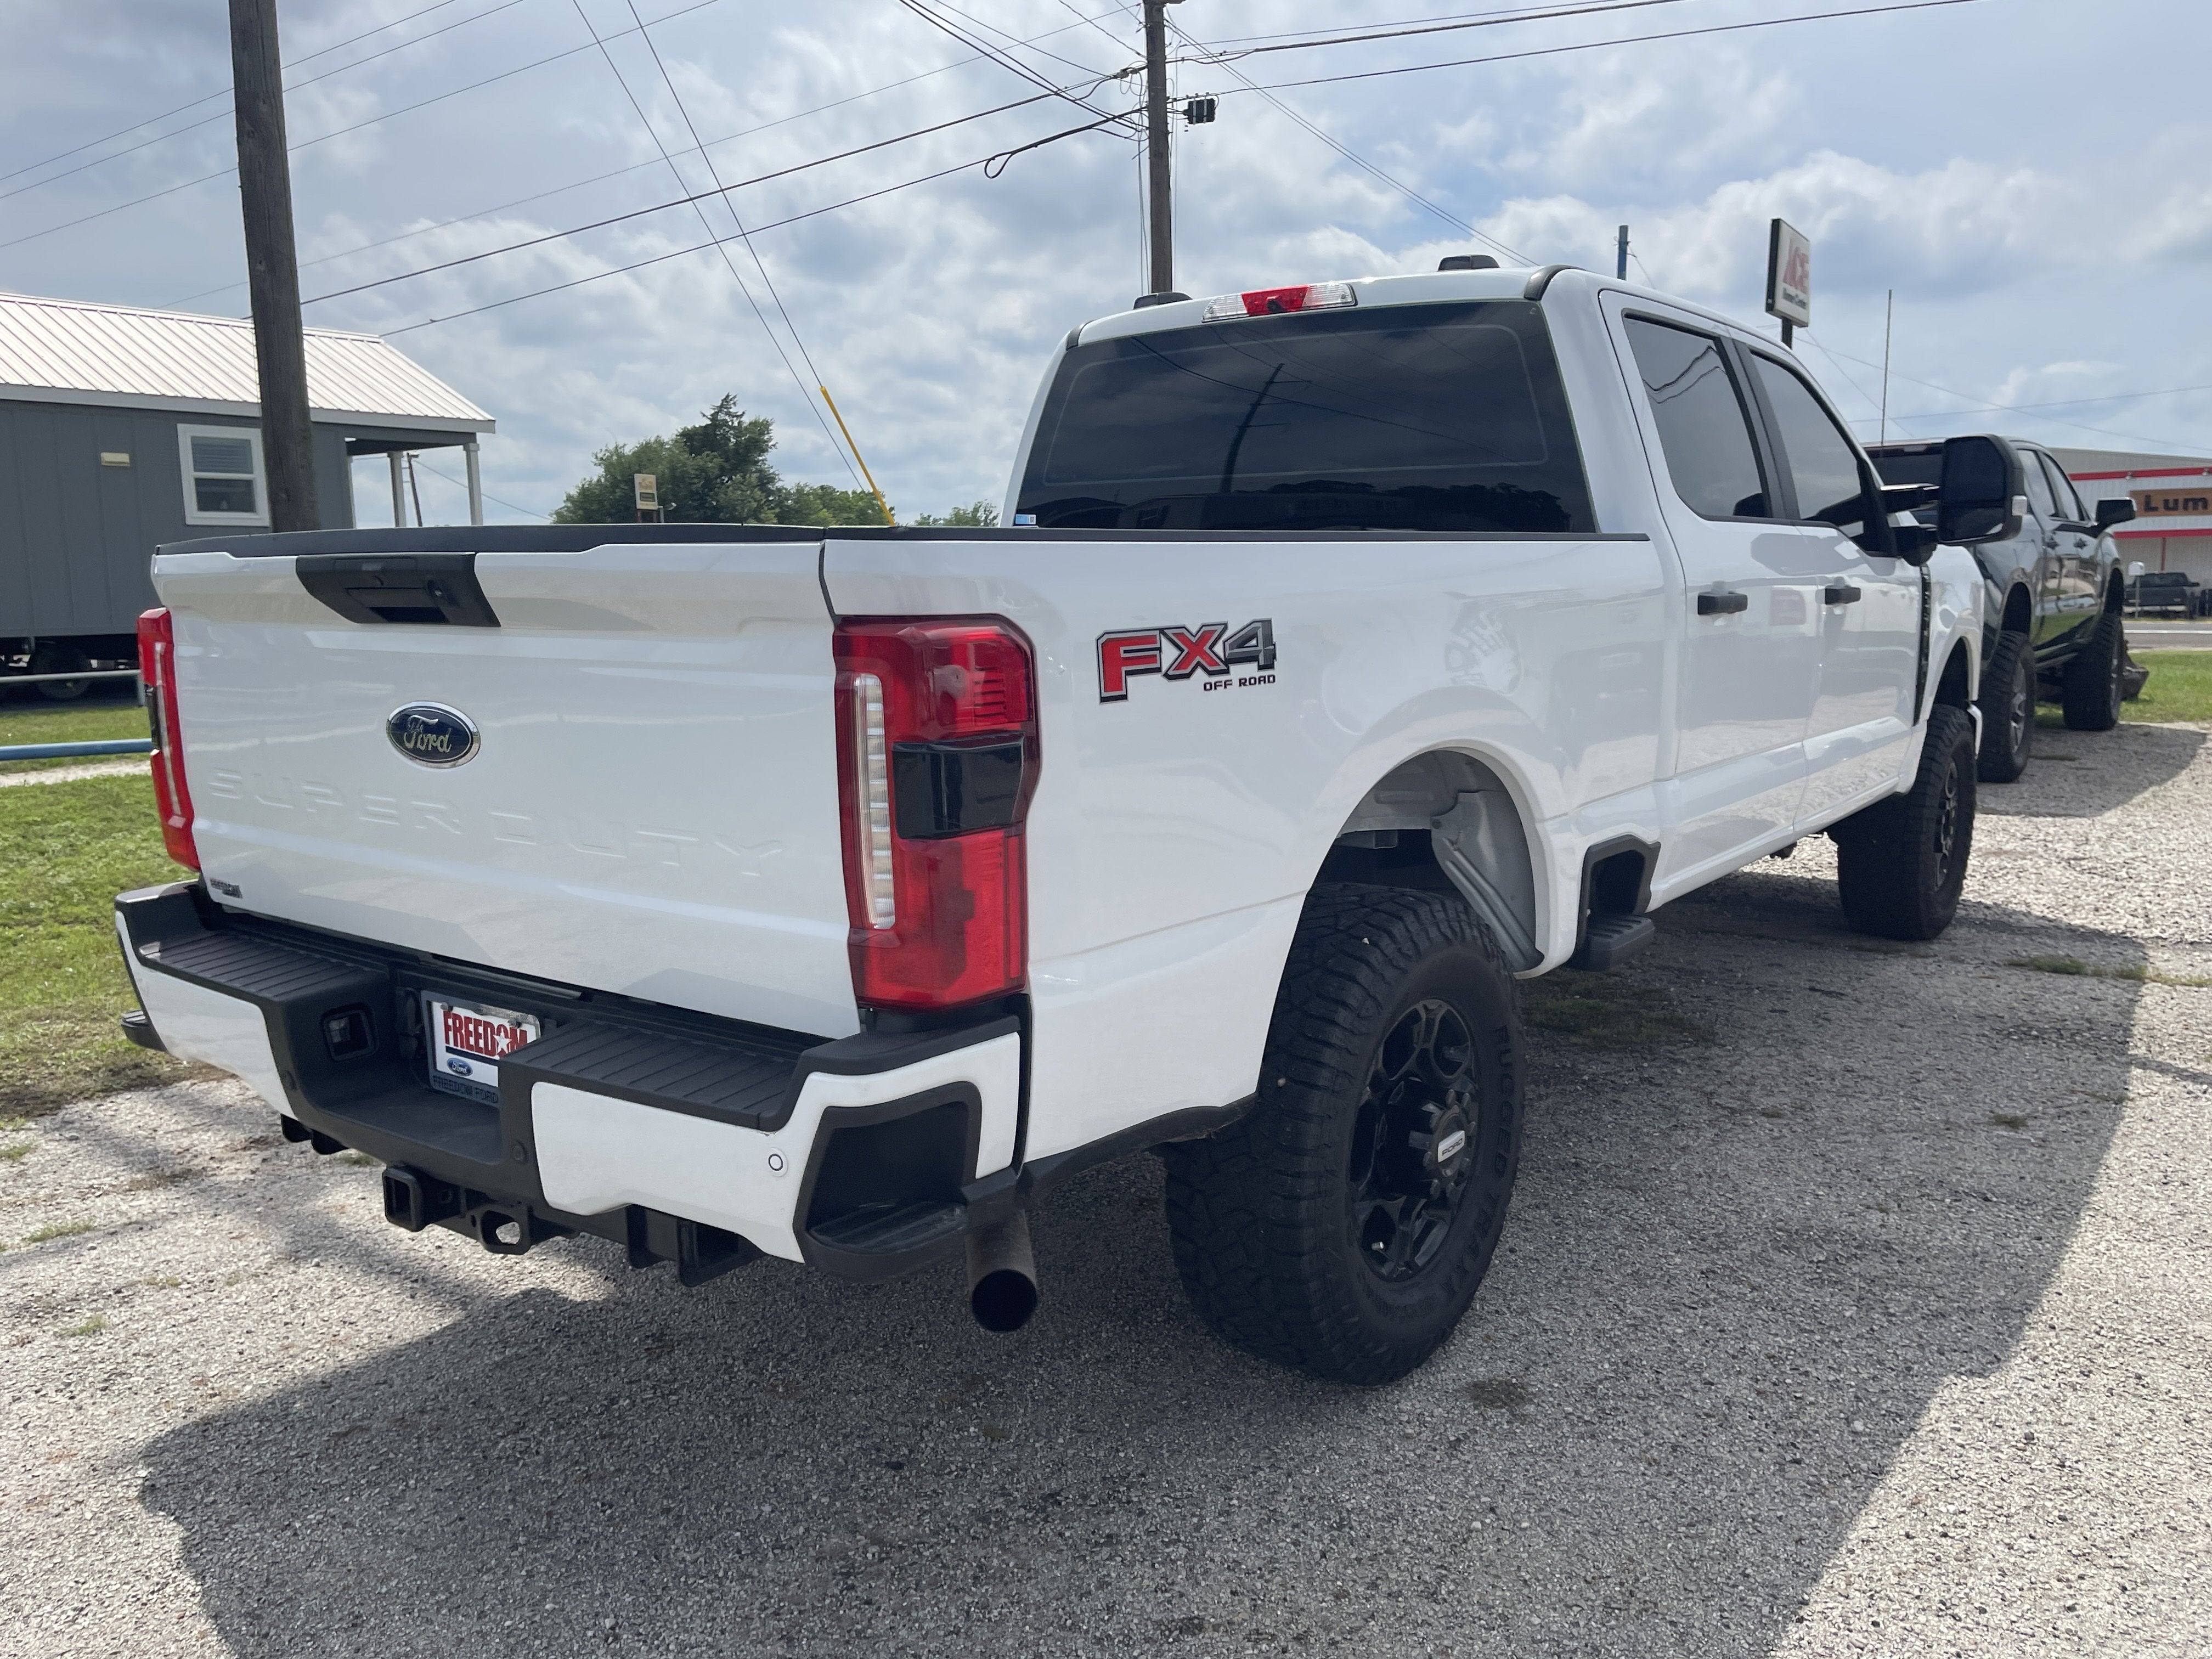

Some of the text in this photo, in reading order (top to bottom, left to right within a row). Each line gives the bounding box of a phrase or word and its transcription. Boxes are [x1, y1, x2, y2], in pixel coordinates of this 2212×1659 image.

[1782, 236, 1809, 295] ACE
[2144, 494, 2209, 512] Lum
[1095, 618, 1277, 705] FX4
[1203, 674, 1276, 692] OFF ROAD
[403, 715, 452, 753] Ford
[207, 769, 783, 877] SUPER DUTY
[443, 1011, 528, 1059] FREEDOM
[451, 1060, 469, 1074] Ford
[475, 1087, 499, 1104] FORD
[1493, 1024, 1515, 1179] RUGGED
[1442, 1138, 1463, 1156] FORD
